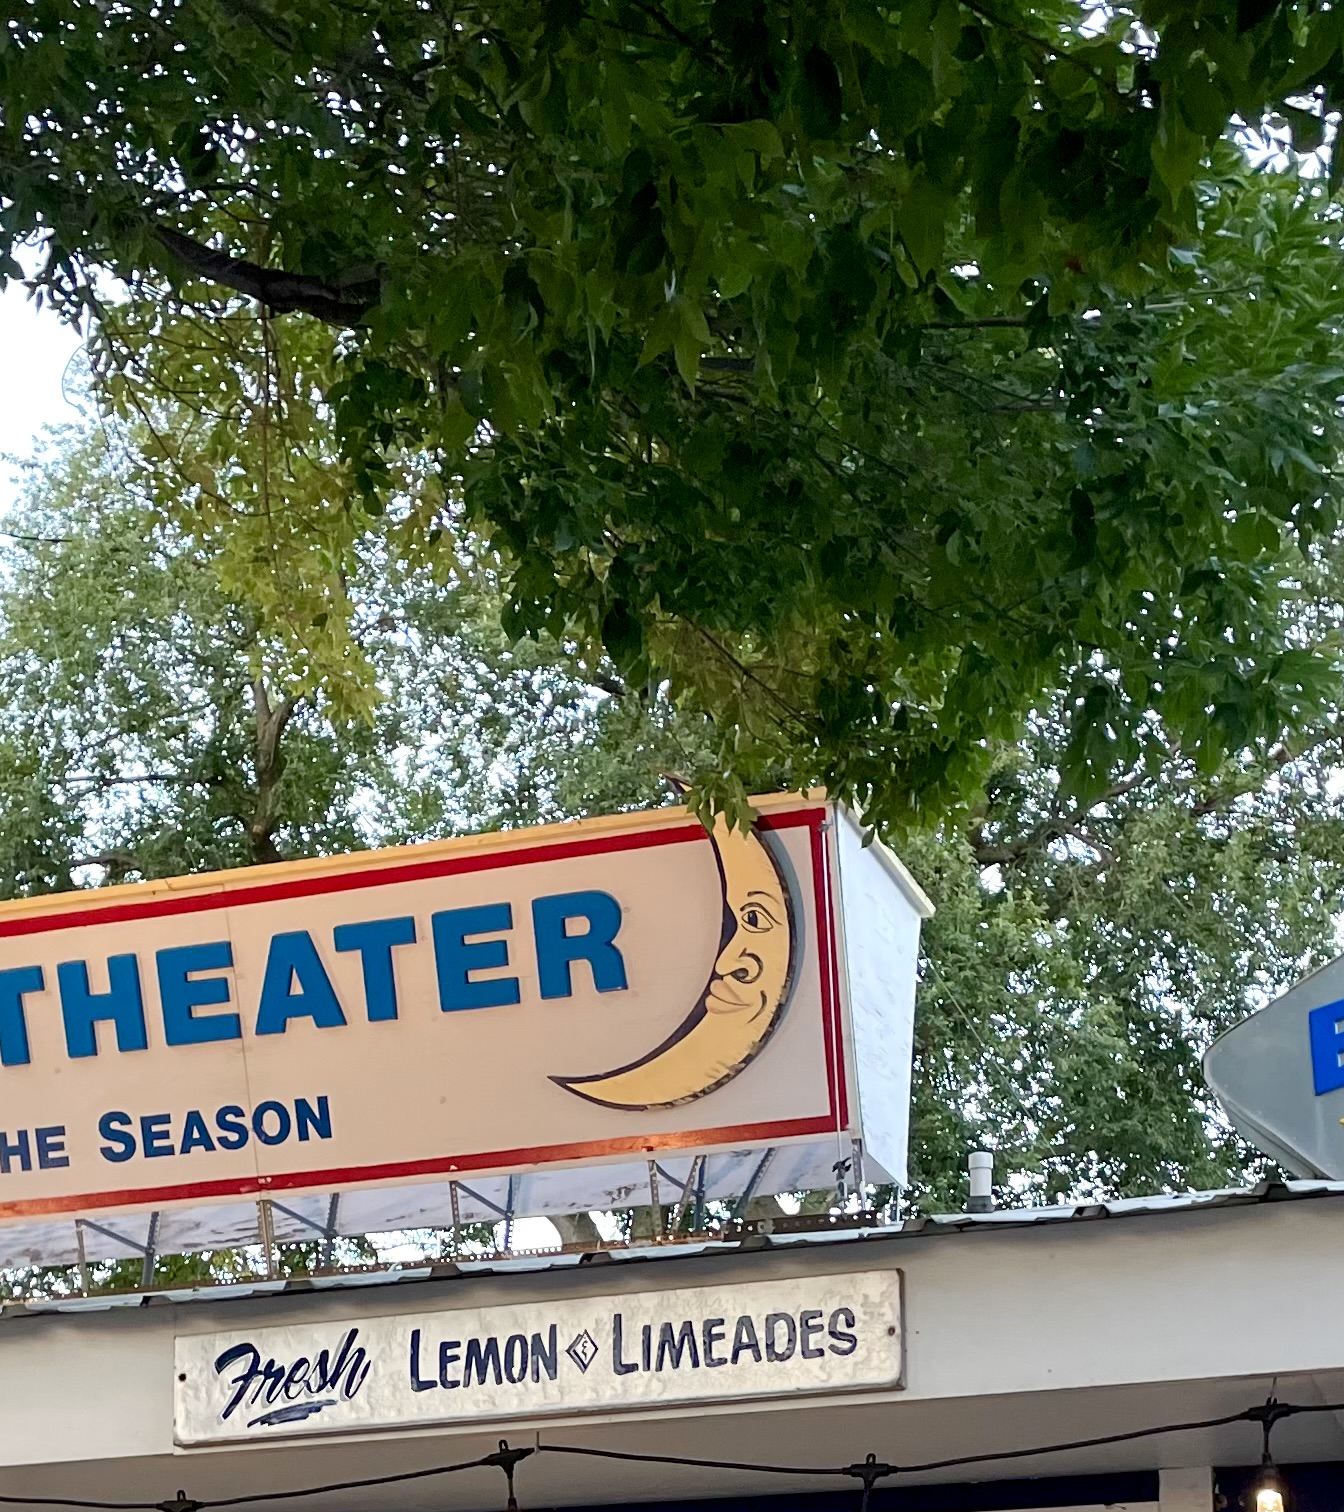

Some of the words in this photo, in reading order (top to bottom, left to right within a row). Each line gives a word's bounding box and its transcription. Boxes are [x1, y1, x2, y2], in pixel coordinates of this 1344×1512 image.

[100, 1095, 333, 1163] SEASON
[214, 1326, 371, 1424] Fresh
[410, 1324, 558, 1393] LEMON
[612, 1308, 858, 1375] LIMEADES
